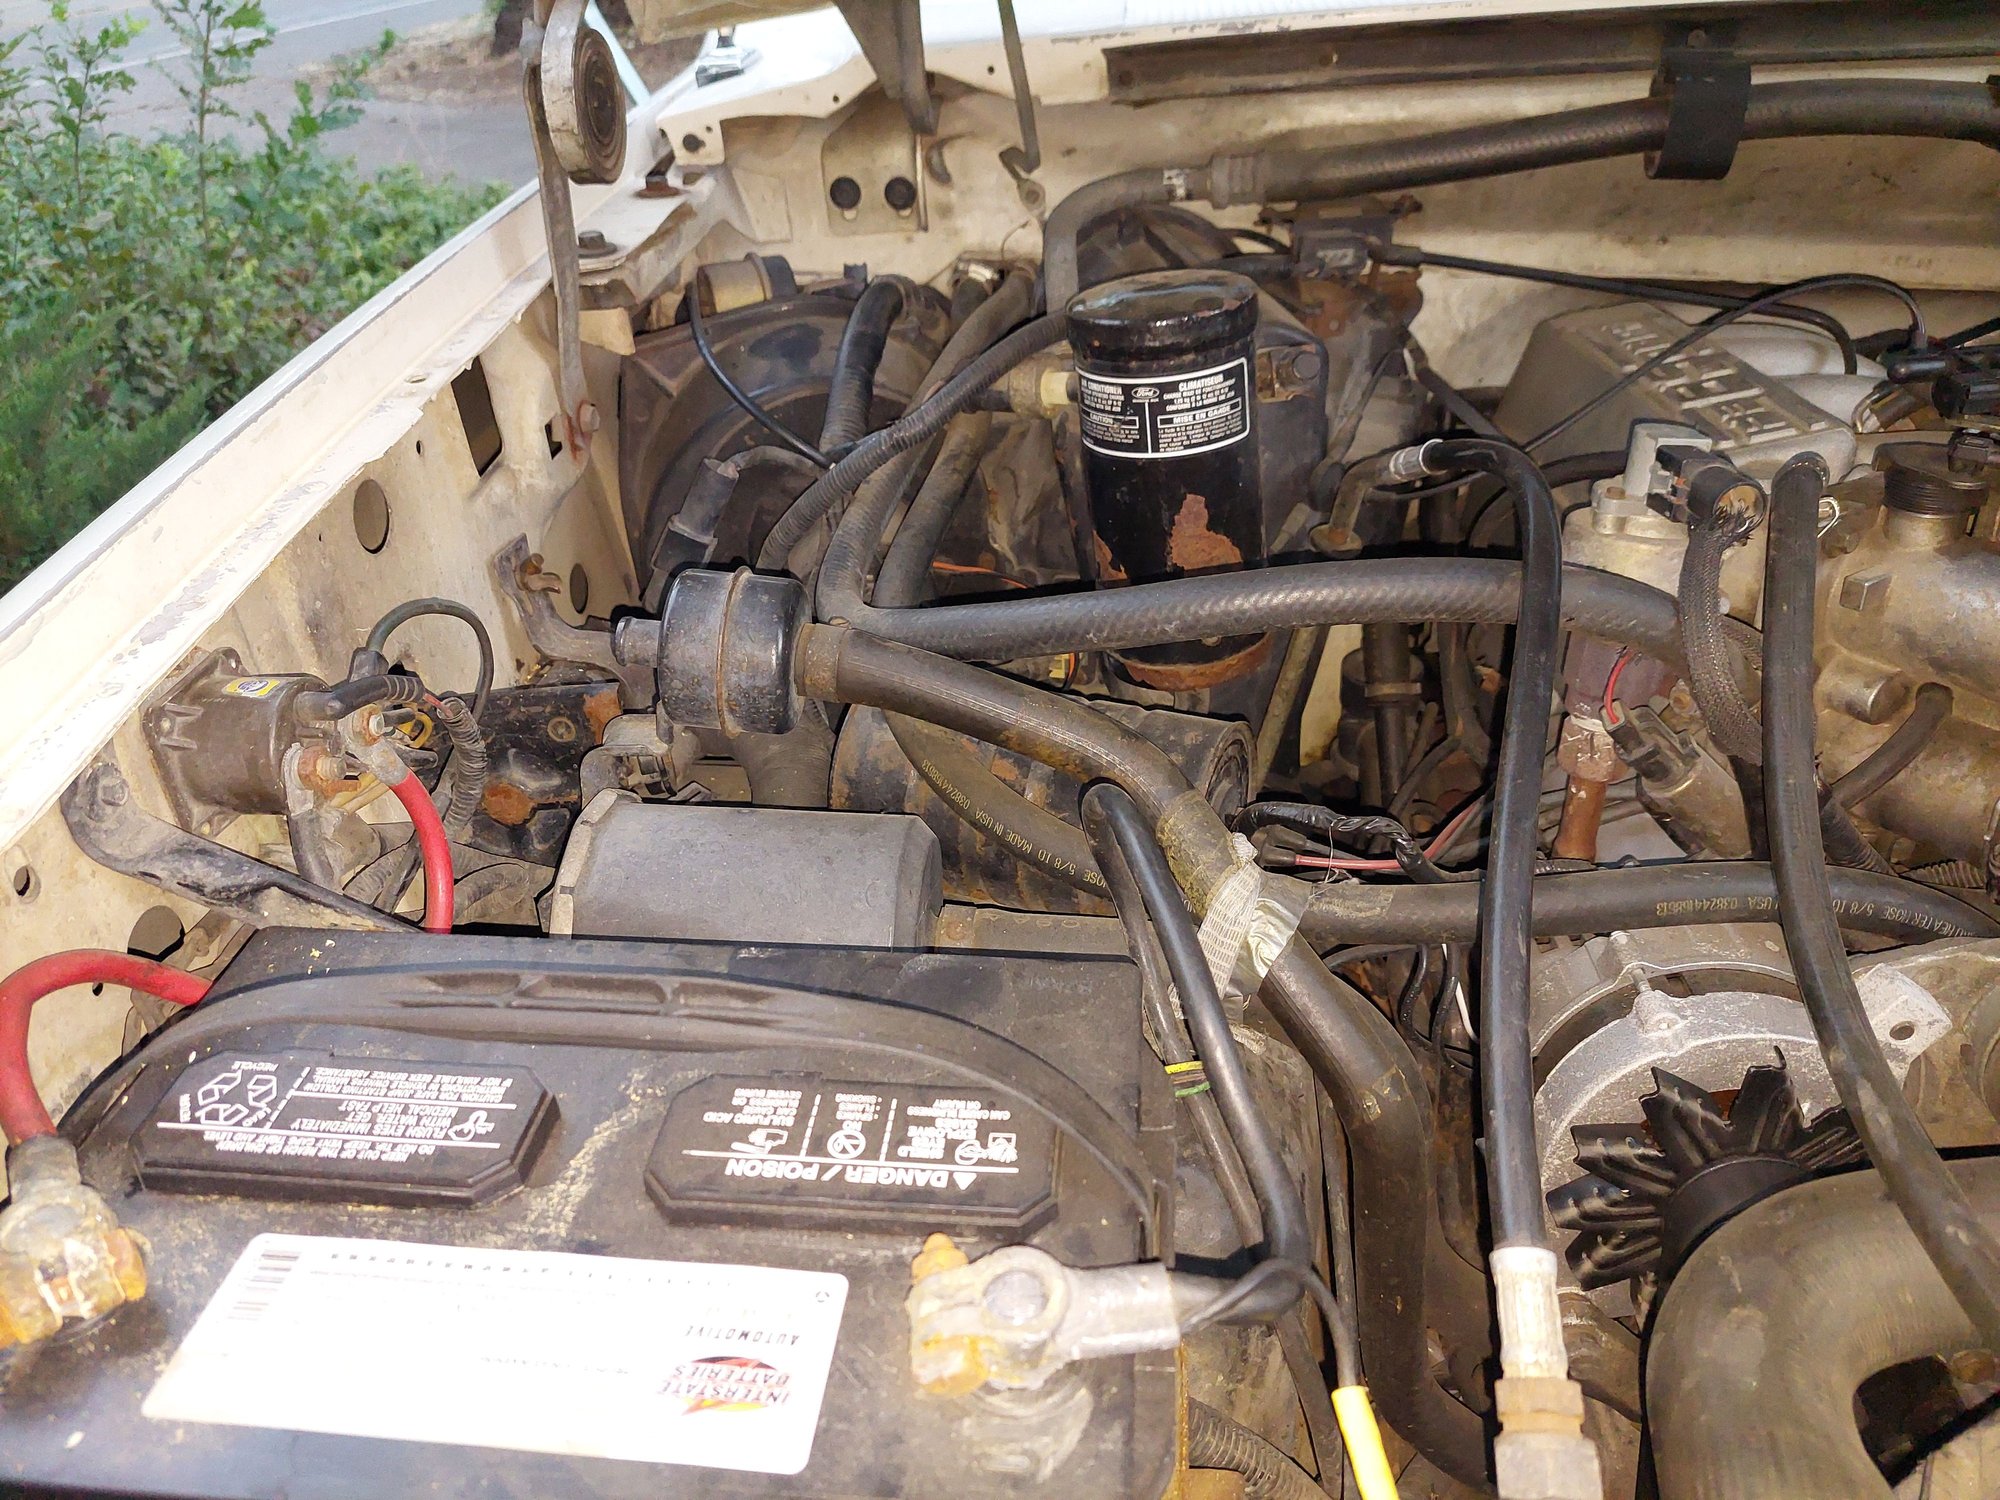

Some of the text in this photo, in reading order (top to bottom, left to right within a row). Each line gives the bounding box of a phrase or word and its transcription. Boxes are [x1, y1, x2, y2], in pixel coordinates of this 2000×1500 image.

[1179, 374, 1224, 392] CLIMATISEUR
[1090, 413, 1114, 424] CAUTION
[1173, 415, 1193, 424] MISE
[1195, 412, 1206, 420] EN
[1208, 405, 1230, 417] GARDE
[975, 810, 994, 828] USA
[993, 822, 1004, 836] IN
[1005, 831, 1033, 854] MADE
[1054, 858, 1076, 875] 5/8
[1747, 895, 1772, 909] USA
[1850, 902, 1875, 916] 5/8
[1879, 905, 1911, 923] HOSE
[1911, 912, 1955, 937] HEATER
[231, 1060, 278, 1072] RECYCLE
[369, 1069, 408, 1080] SERVICE
[480, 1076, 502, 1086] NOT
[389, 1079, 427, 1089] VEHICLE
[427, 1082, 440, 1090] IN
[386, 1087, 413, 1096] JUMP
[438, 1090, 459, 1099] FOR
[730, 1096, 747, 1105] OR
[337, 1099, 458, 1117] MEDICAL HELP FAST
[344, 1110, 371, 1122] GET
[420, 1115, 452, 1127] WITH
[702, 1111, 795, 1126] SULFURIC ACID
[291, 1116, 447, 1139] FLUSH EYES IMMEDIATELY
[842, 1119, 861, 1131] NO
[231, 1132, 255, 1143] AND
[906, 1125, 976, 1140] EXPLOSIVE
[395, 1143, 417, 1154] NOT
[723, 1157, 948, 1188] DANGER / POISON
[683, 1324, 799, 1346] AUTOMOTIVE
[671, 1364, 791, 1387] BATTERIES
[655, 1379, 790, 1406] INTERSTATE
